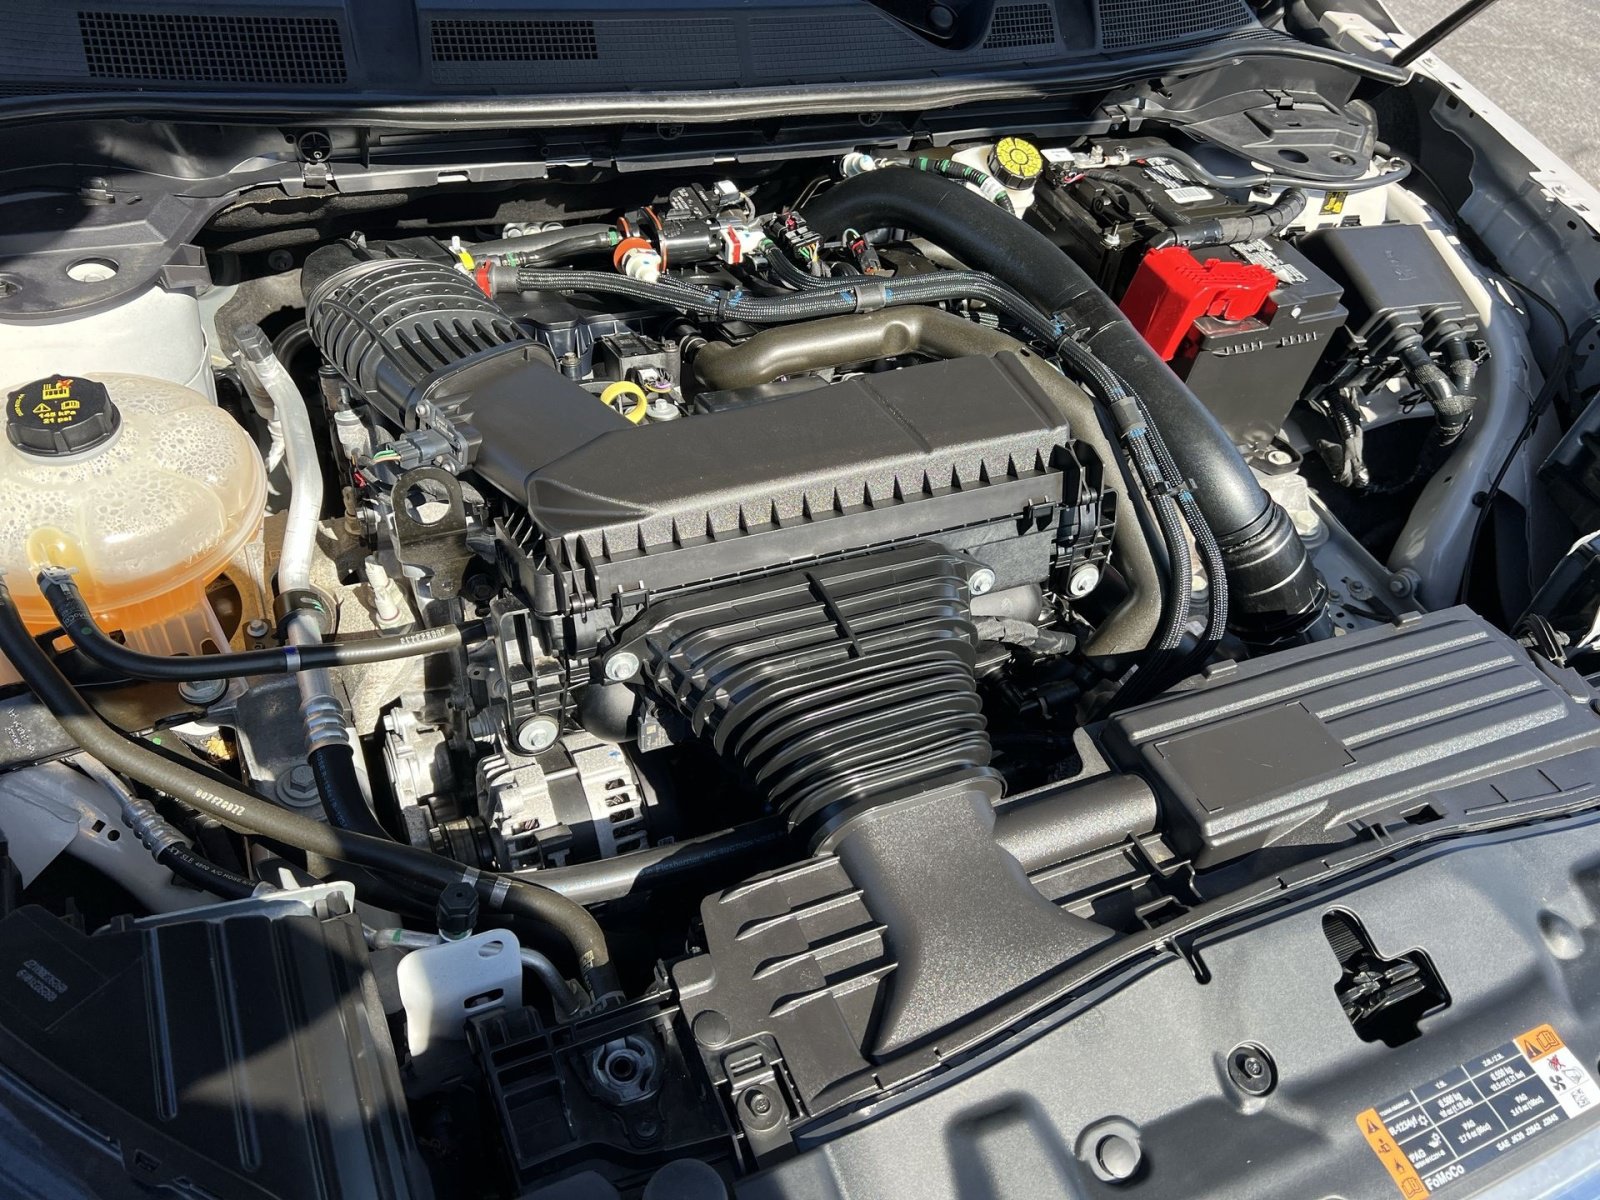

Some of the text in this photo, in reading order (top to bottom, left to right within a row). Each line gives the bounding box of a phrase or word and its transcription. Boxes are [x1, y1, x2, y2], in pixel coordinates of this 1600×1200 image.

[223, 873, 242, 882] HOSE
[1503, 1066, 1514, 1074] kg
[1451, 1092, 1463, 1100] kg
[1514, 1093, 1527, 1103] PAG
[1387, 1114, 1417, 1136] R-1234yf
[1461, 1119, 1476, 1130] PAG
[1495, 1138, 1511, 1150] SAE
[1407, 1148, 1426, 1162] PAG
[1424, 1164, 1465, 1190] FoMoCo
